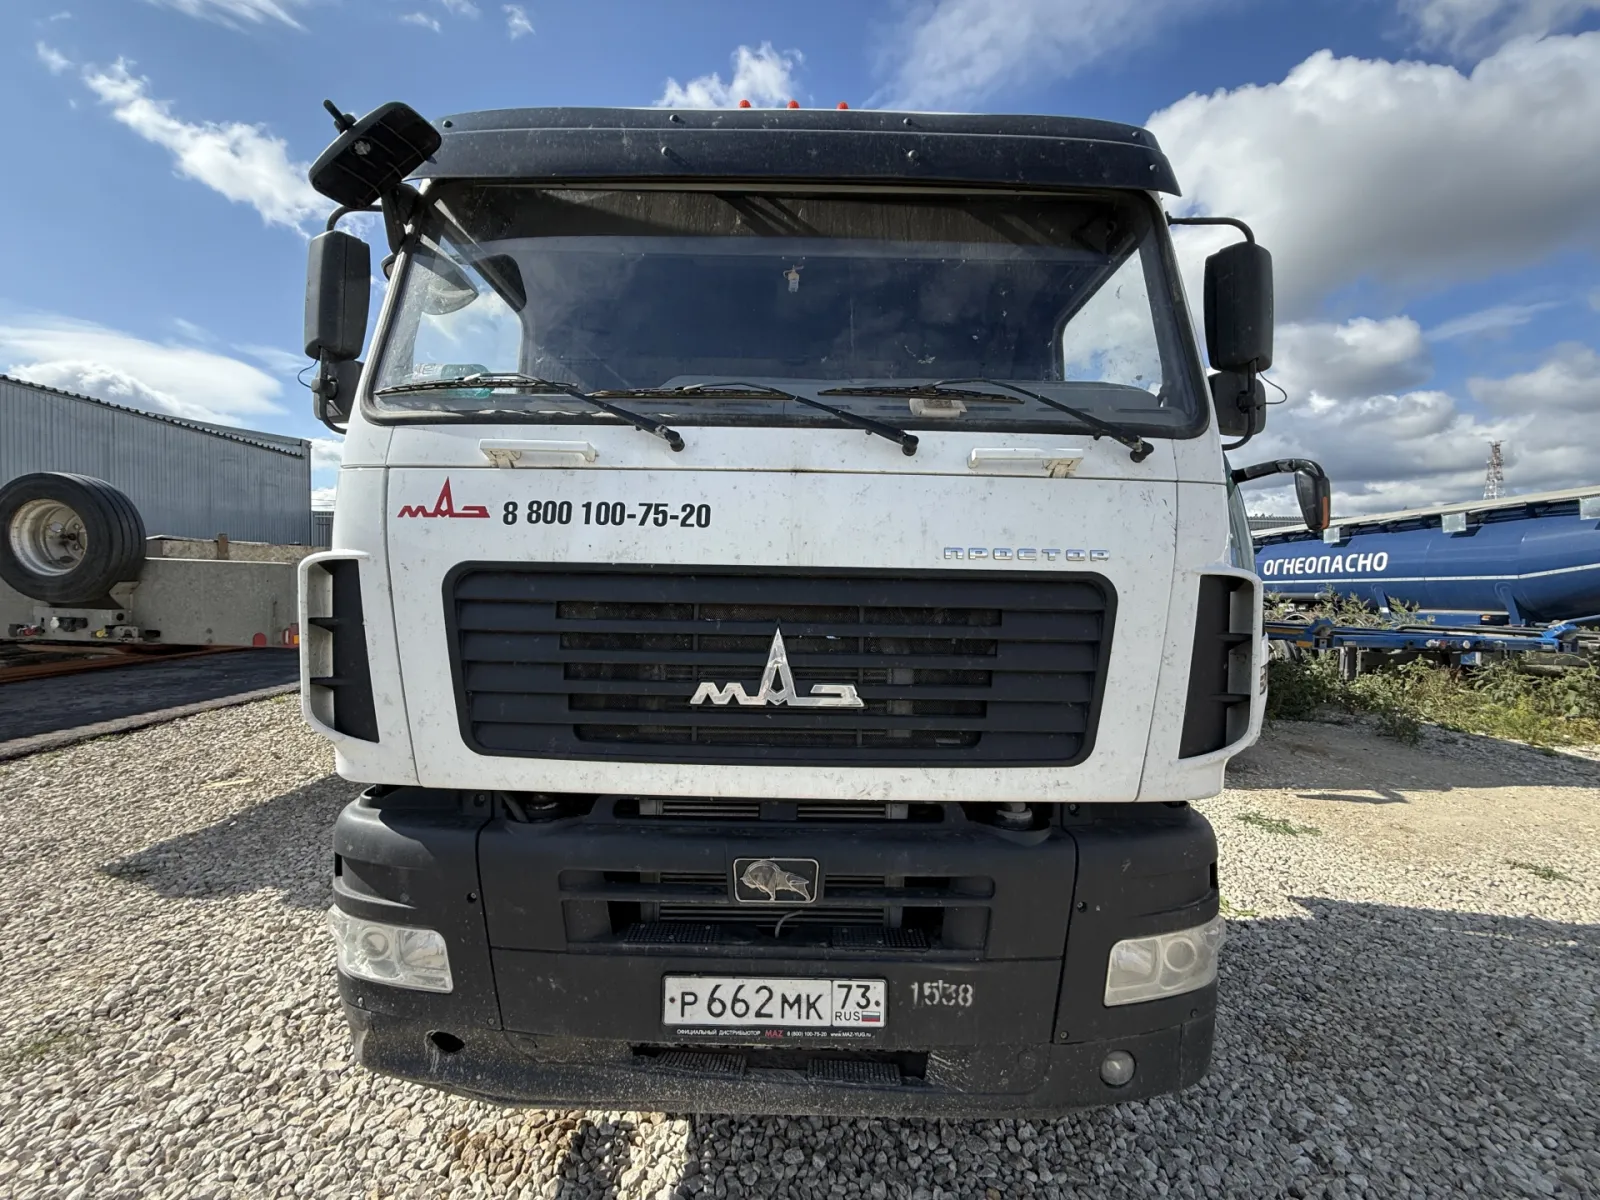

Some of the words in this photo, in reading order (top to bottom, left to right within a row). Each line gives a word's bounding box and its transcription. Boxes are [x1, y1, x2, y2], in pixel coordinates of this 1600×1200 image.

[502, 501, 518, 525] 8
[526, 500, 573, 525] 800
[581, 501, 711, 528] 100-75-20
[943, 547, 1110, 562] ПРОСТОР
[1263, 552, 1388, 575] ОГНЕОПАСНО
[837, 984, 871, 1010] 73
[834, 1011, 861, 1022] RUS
[764, 1029, 784, 1038] MAZ
